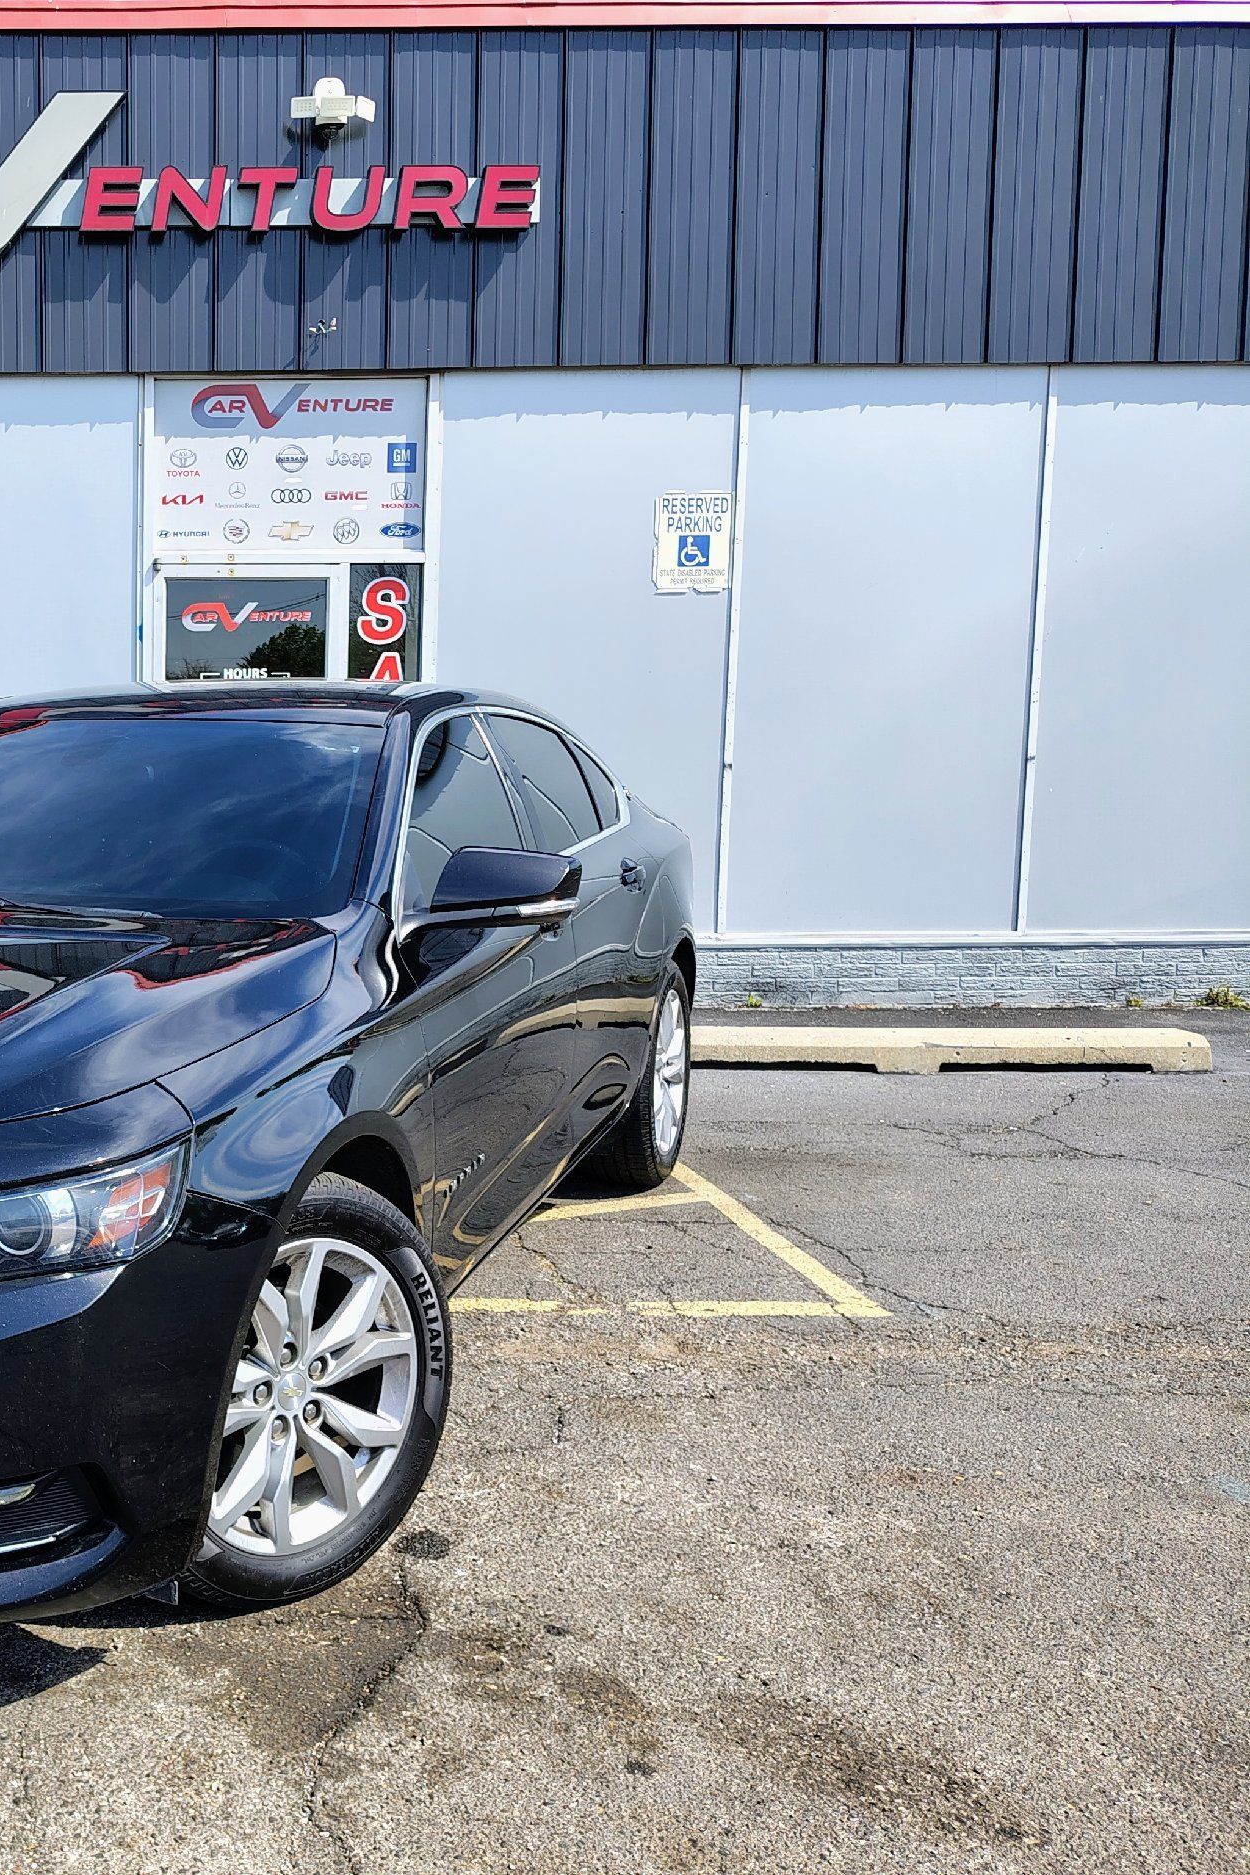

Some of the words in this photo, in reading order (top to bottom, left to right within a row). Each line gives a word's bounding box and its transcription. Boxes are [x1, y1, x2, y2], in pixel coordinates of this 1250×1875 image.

[277, 455, 308, 464] NISSAN
[325, 449, 372, 468] Jeep
[393, 448, 410, 463] GM
[166, 470, 201, 478] TOYOTA
[324, 490, 368, 501] GMC
[661, 496, 729, 514] RESERVED
[667, 515, 722, 533] PARKING
[222, 667, 268, 680] HOURS
[410, 1271, 445, 1382] RELIANT
